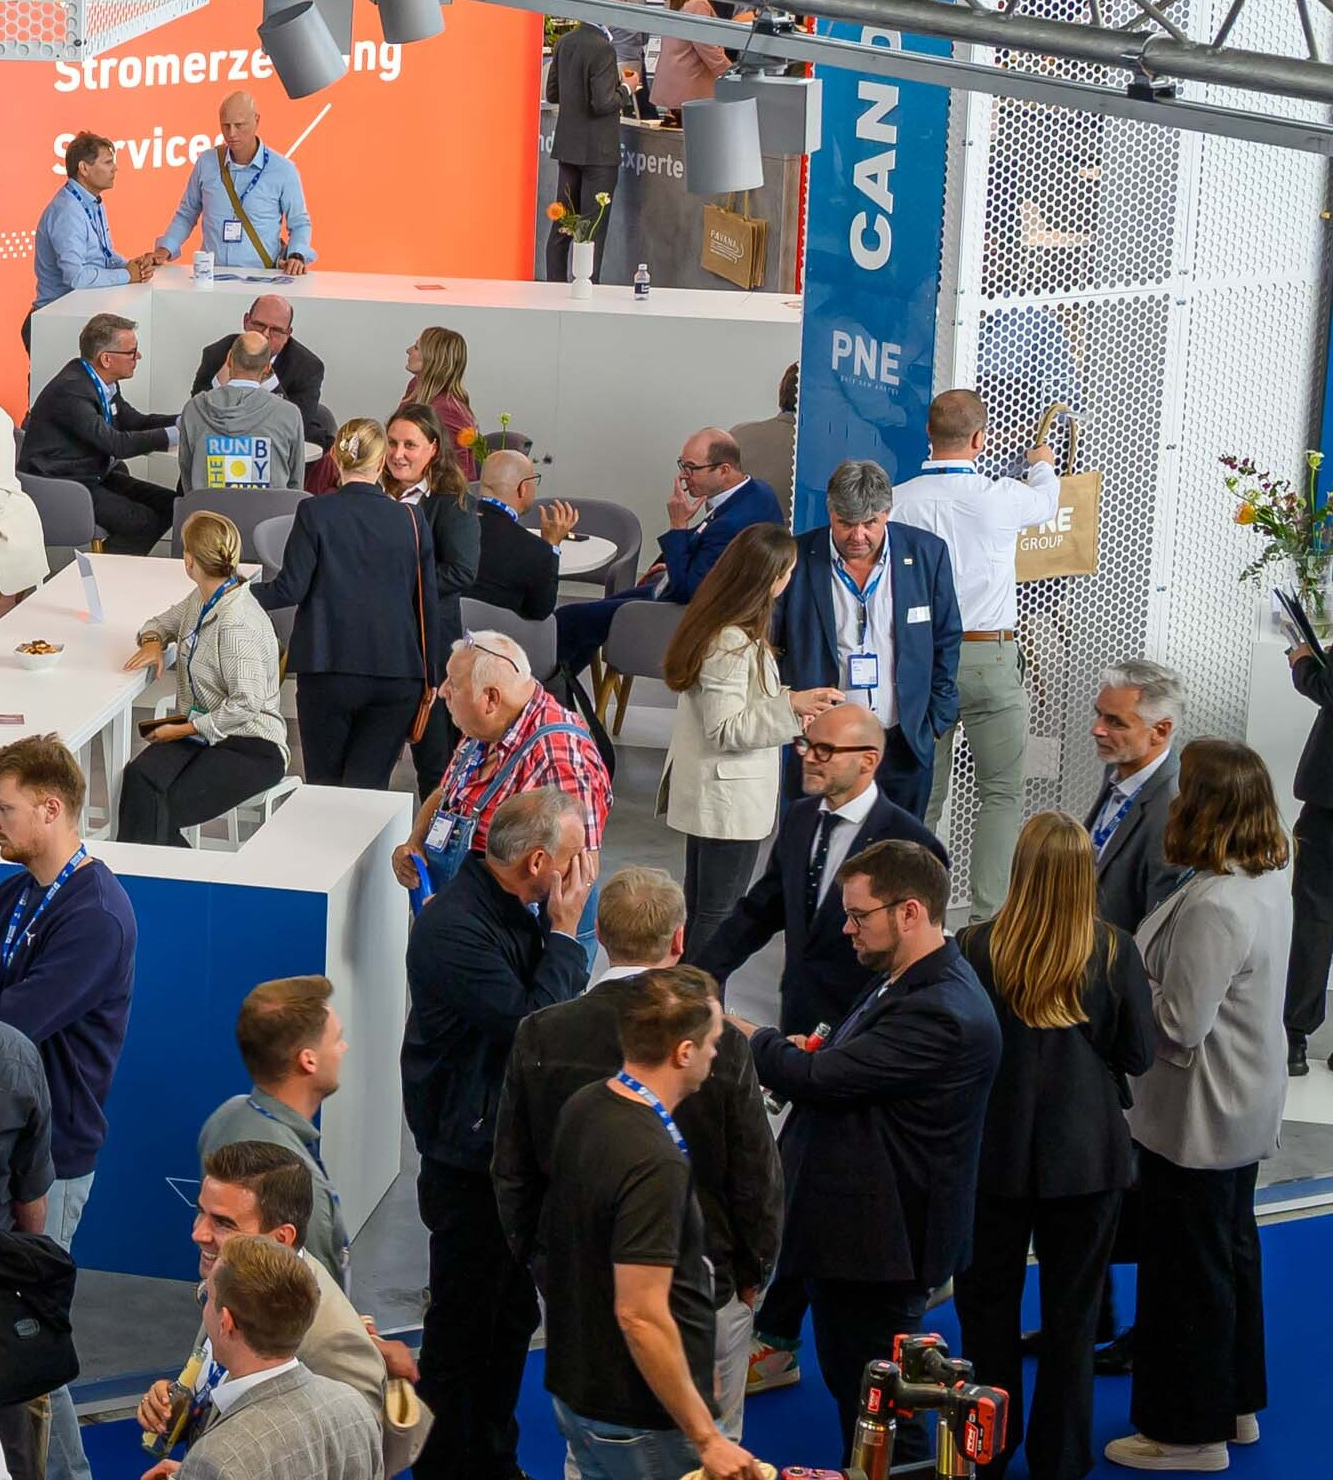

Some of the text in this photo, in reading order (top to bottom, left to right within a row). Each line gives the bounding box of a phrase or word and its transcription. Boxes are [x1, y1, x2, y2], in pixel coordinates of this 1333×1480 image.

[53, 38, 402, 93] Stromerzeng
[52, 126, 226, 176] Srvice
[831, 329, 902, 386] PNE
[209, 438, 250, 454] RUN
[1021, 507, 1074, 536] NE
[1020, 535, 1063, 551] GROUP
